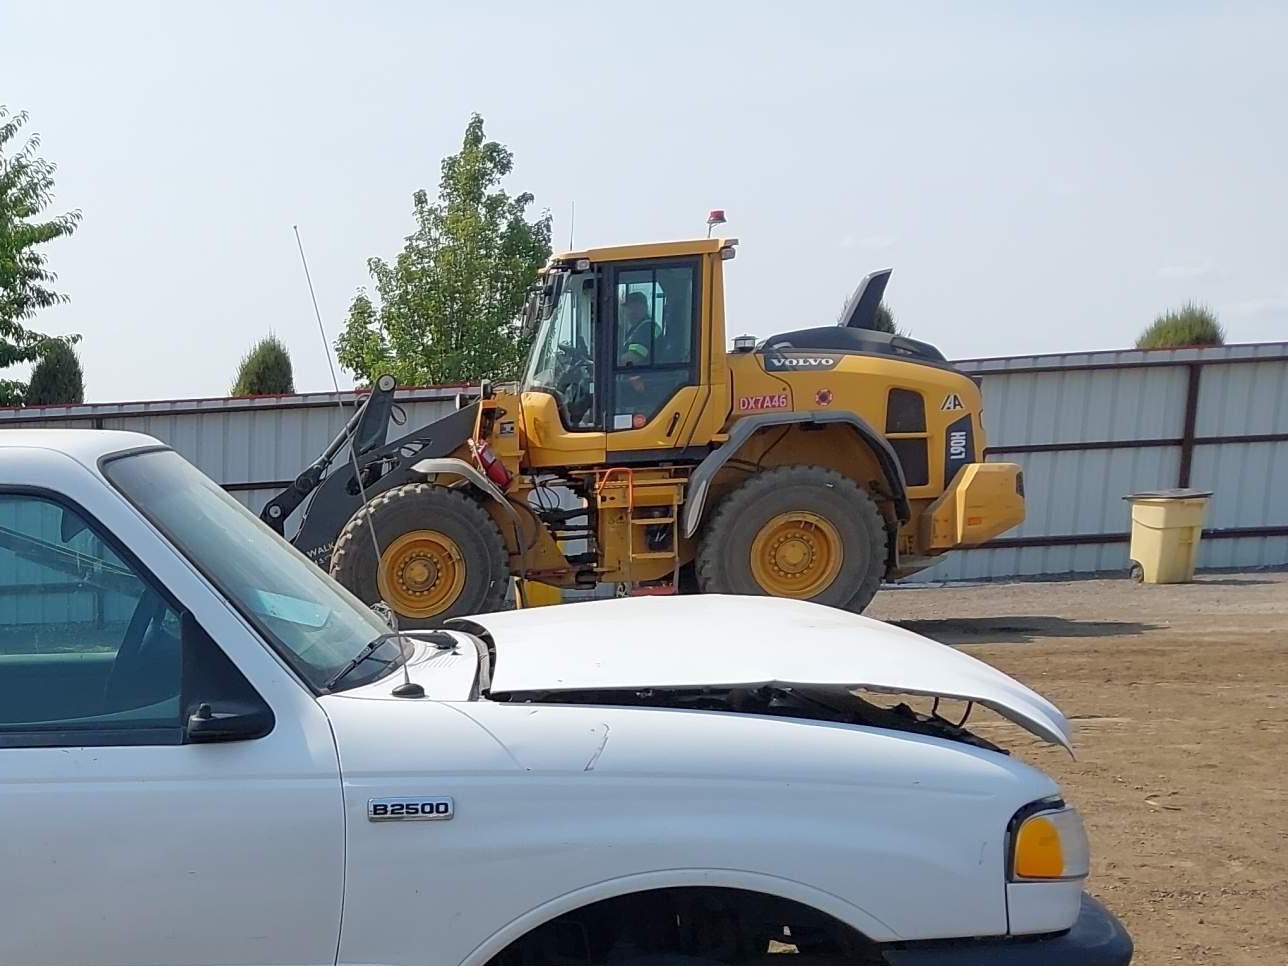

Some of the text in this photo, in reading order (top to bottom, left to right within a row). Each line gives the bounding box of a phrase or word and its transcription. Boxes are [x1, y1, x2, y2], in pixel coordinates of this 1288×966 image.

[771, 358, 834, 367] VOLVO
[739, 394, 788, 410] DX7A46
[950, 431, 967, 460] L90H
[372, 802, 449, 816] B2500
